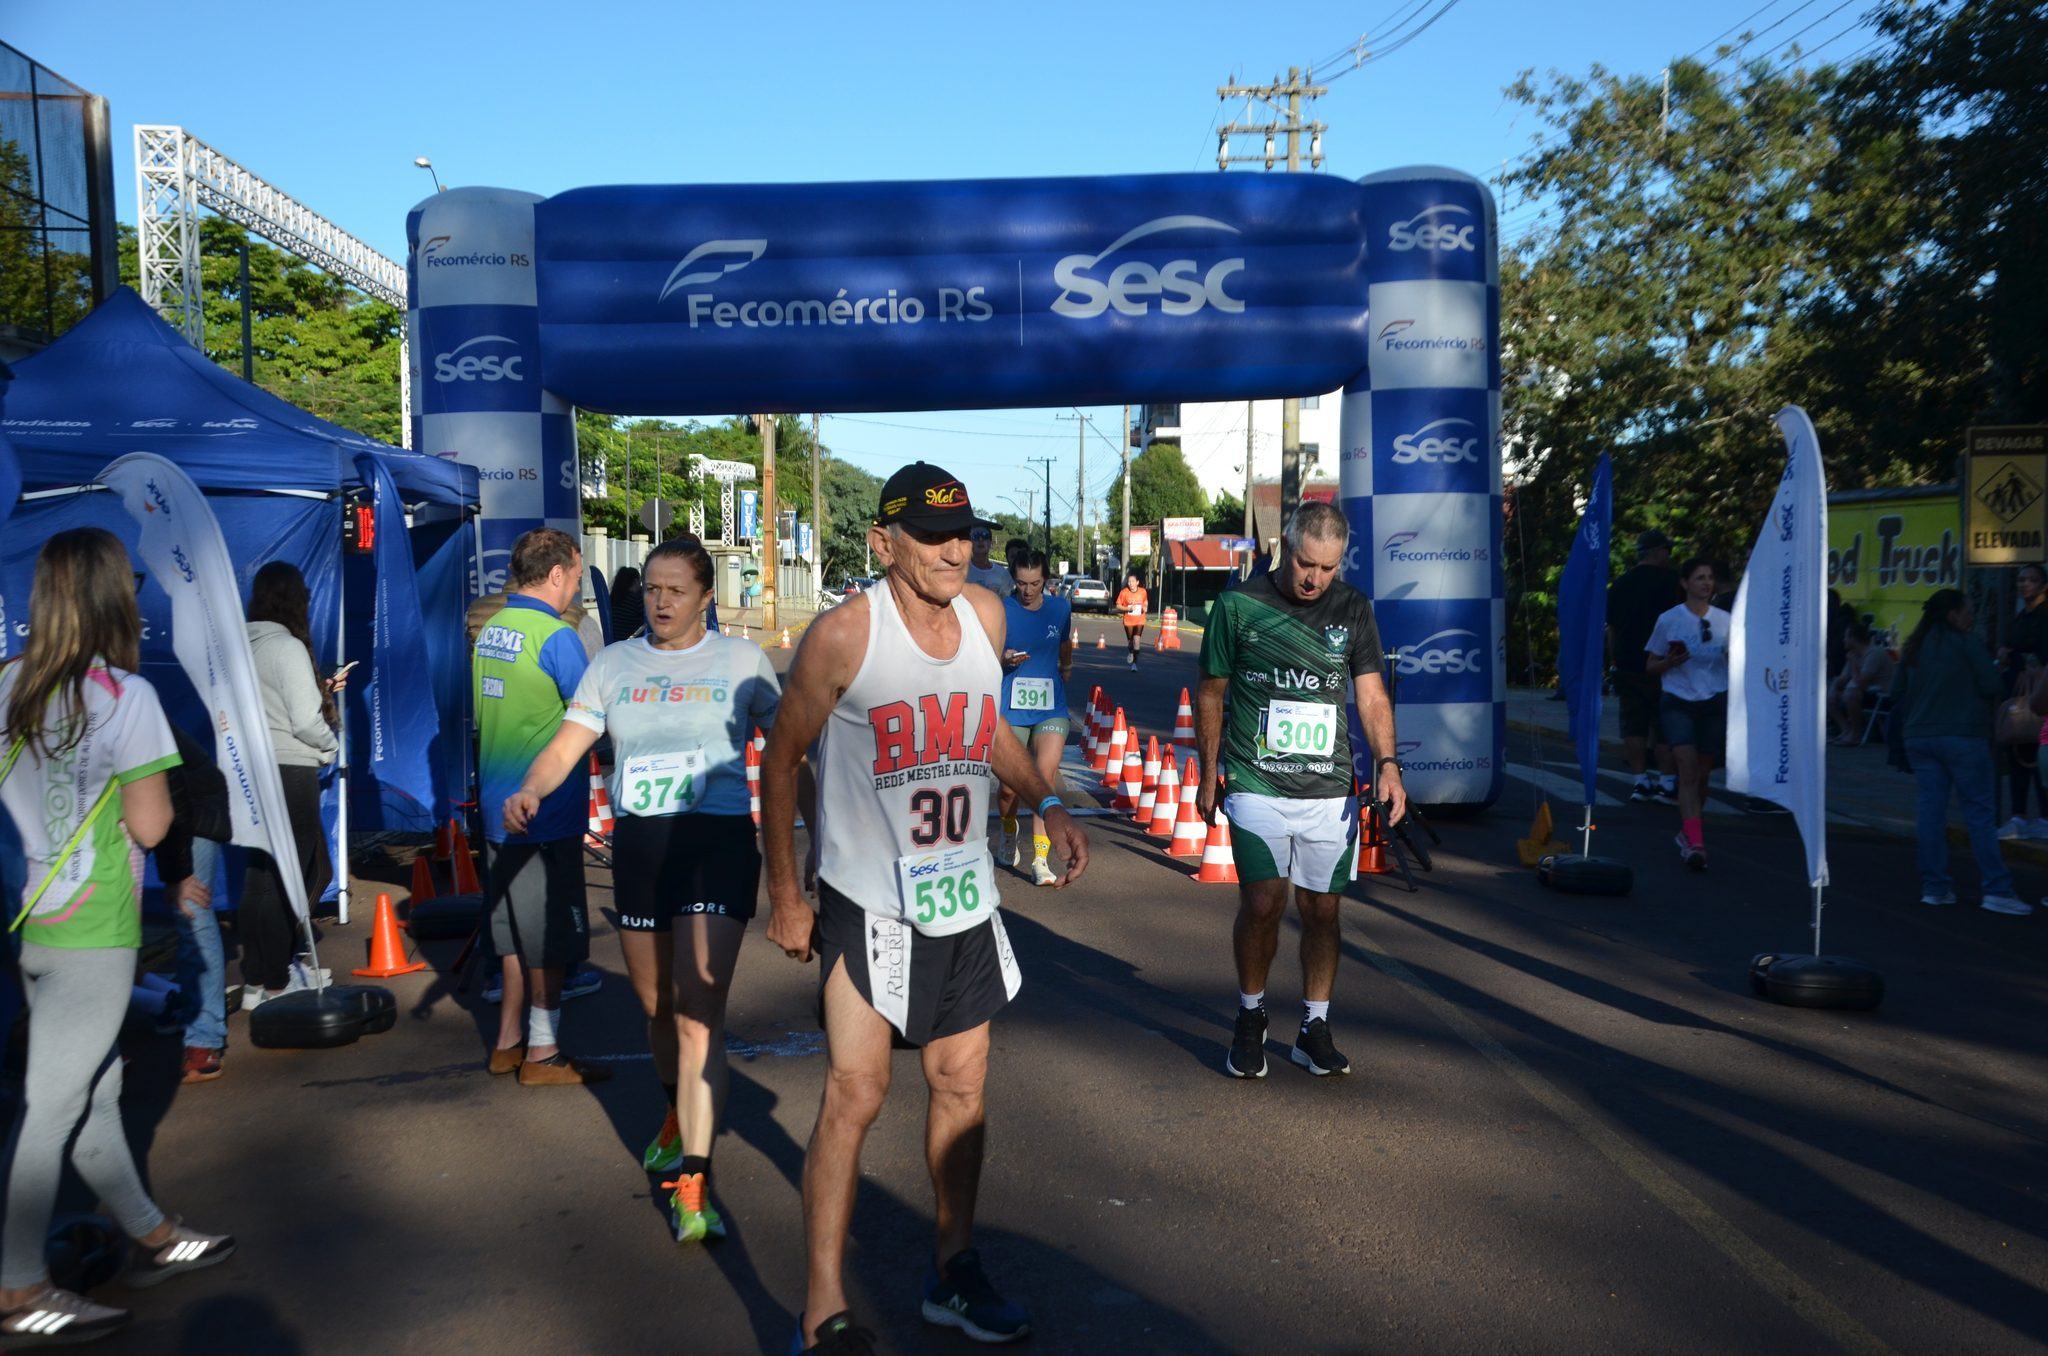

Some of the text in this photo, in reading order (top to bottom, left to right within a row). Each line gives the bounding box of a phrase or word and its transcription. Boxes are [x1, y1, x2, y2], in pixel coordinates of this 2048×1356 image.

[1388, 221, 1475, 251] Sesc
[427, 252, 529, 268] Fecomércio RS
[1050, 255, 1245, 319] Sesc
[688, 286, 993, 328] Fecomércio RS
[1386, 336, 1485, 351] Fecomércio RS
[434, 353, 524, 383] Sesc
[1391, 434, 1478, 464] Sesc
[479, 468, 537, 481] ércio RS
[925, 488, 957, 504] Mel
[1877, 514, 1961, 588] Truck
[1975, 531, 2042, 549] ELEVADA
[1390, 549, 1488, 562] Fecomércio RS
[1779, 565, 1791, 646] Sindicatos
[1396, 645, 1480, 674] Sesc
[1778, 669, 1790, 691] RS
[616, 686, 727, 705] Autismo
[1017, 689, 1048, 707] 391
[1276, 720, 1328, 751] 300
[1775, 694, 1790, 784] Fecomércio
[875, 770, 905, 790] REDE
[906, 764, 950, 783] MESTRE
[1476, 758, 1490, 769] RS
[632, 773, 695, 811] 374
[910, 784, 971, 848] 30
[915, 869, 980, 924] 536
[621, 915, 655, 928] RUN
